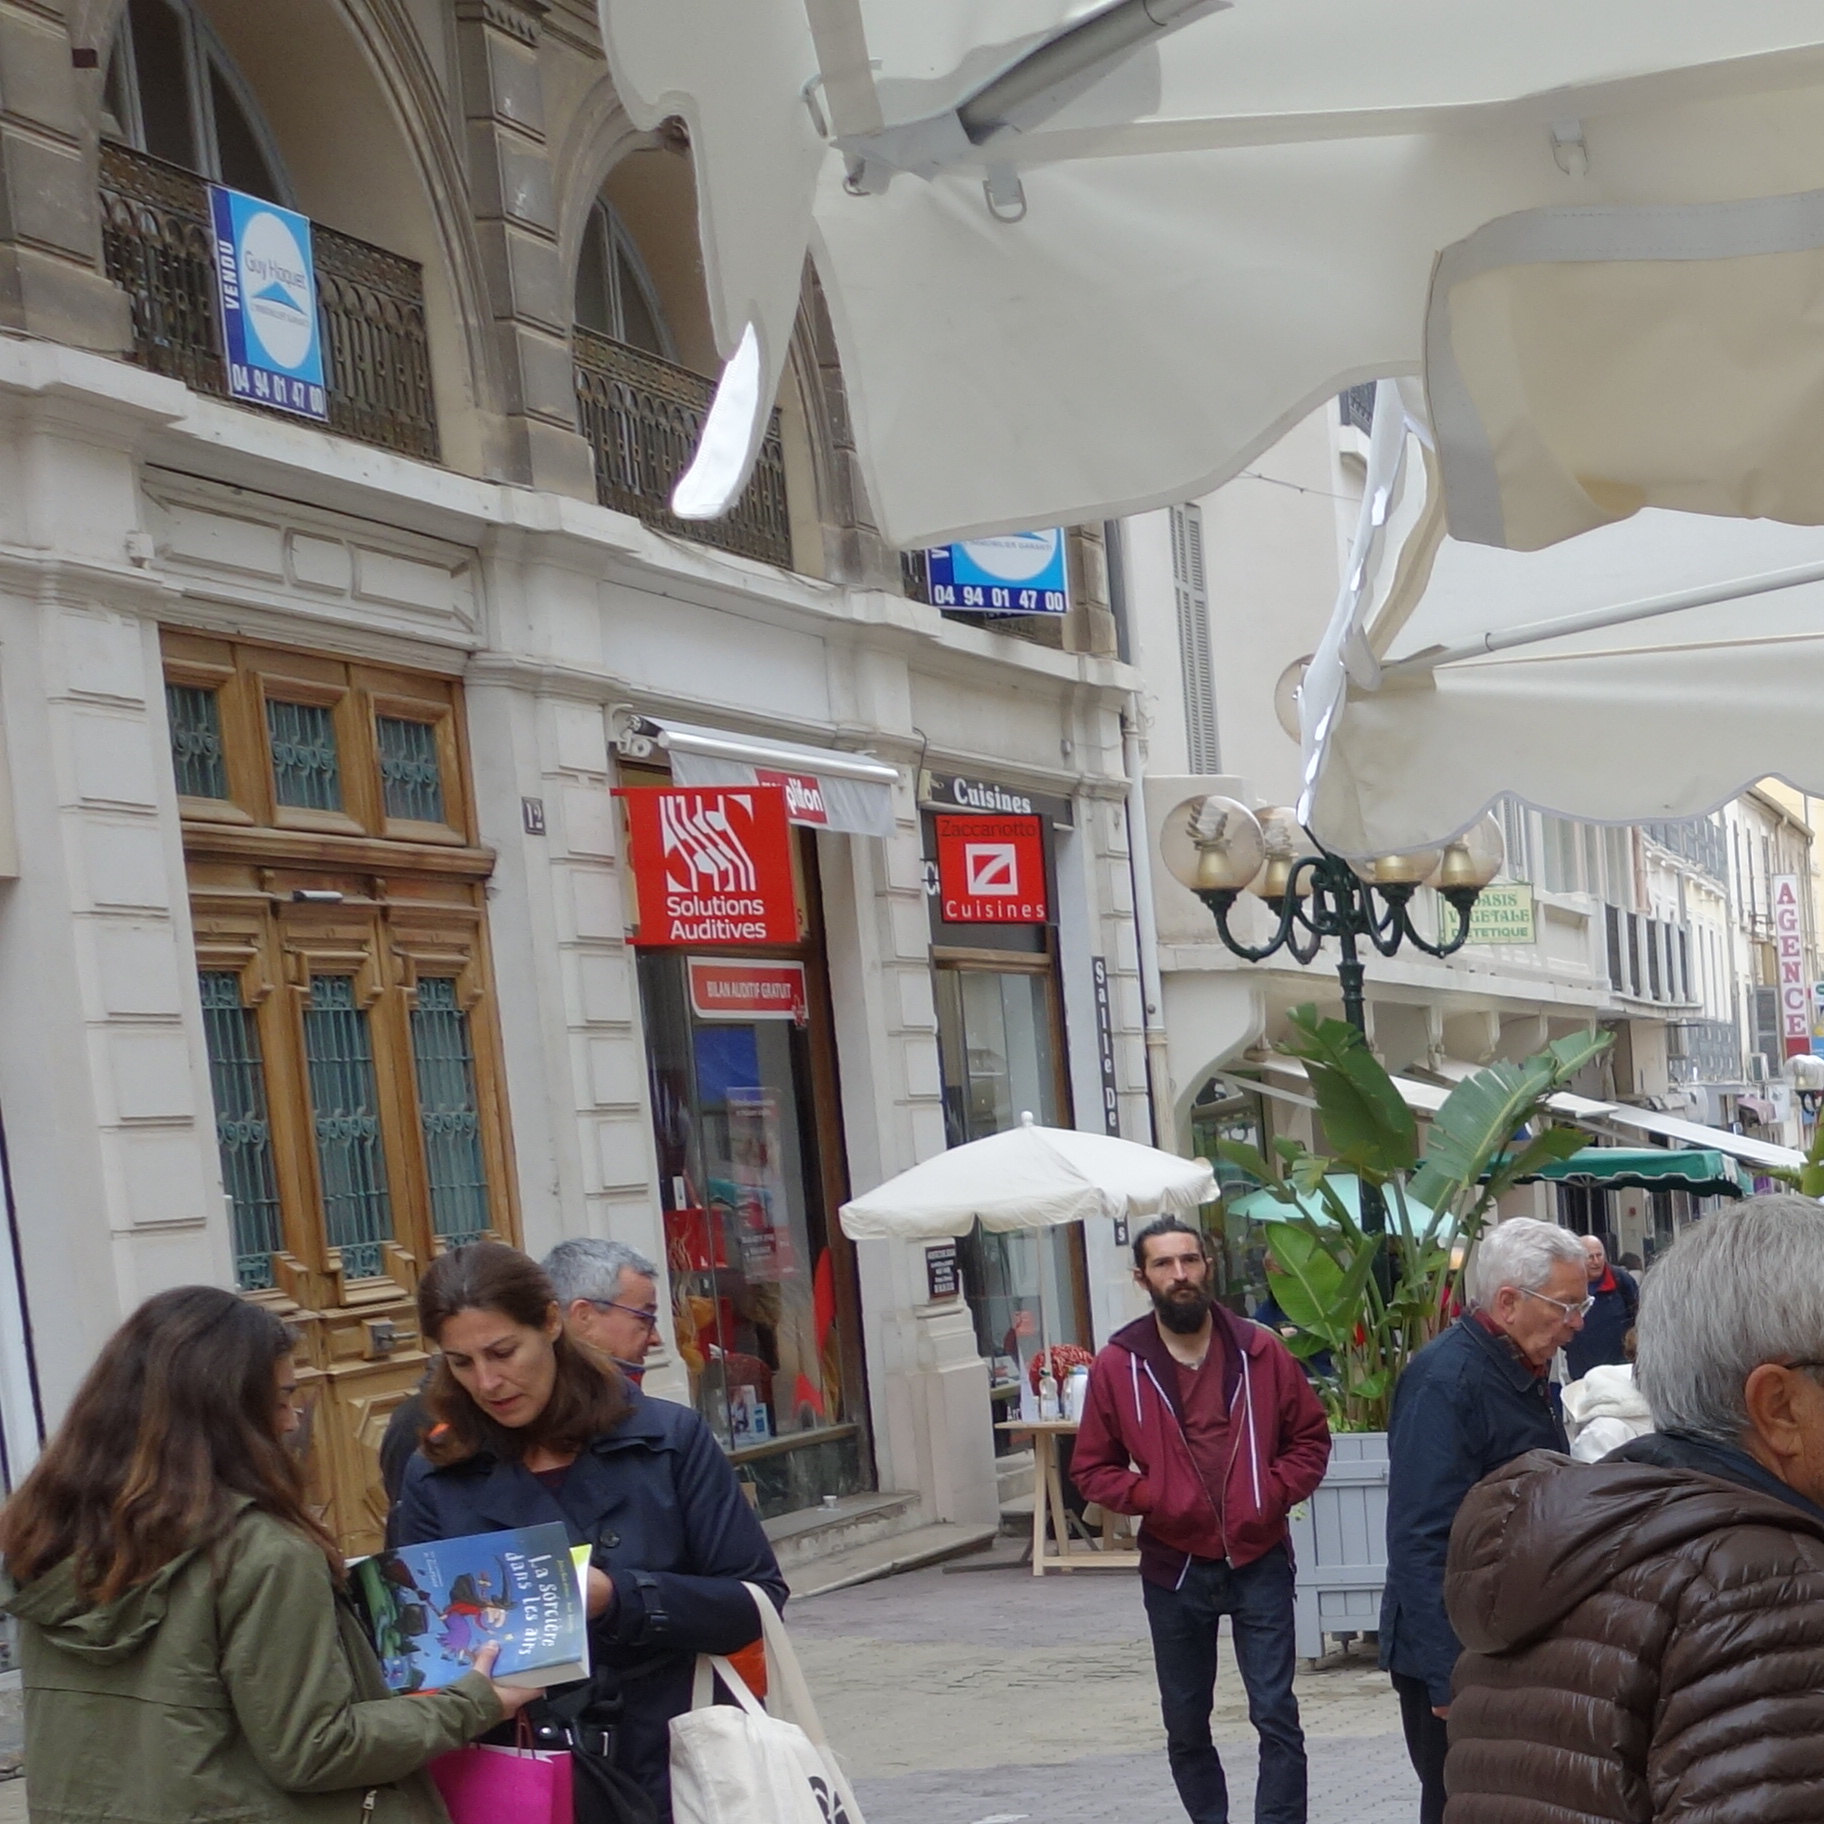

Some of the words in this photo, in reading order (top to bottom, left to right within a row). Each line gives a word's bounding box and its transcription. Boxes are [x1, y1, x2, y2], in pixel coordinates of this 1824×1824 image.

[219, 240, 240, 310] VENDU
[244, 250, 268, 281] Guy
[232, 364, 250, 393] 04
[254, 370, 270, 398] 94
[274, 375, 288, 403] 01
[292, 380, 305, 408] 47
[309, 385, 324, 414] 00
[934, 585, 955, 605] 04
[963, 586, 984, 606] 94
[991, 587, 1010, 607] 01
[1019, 590, 1037, 609] 47
[1045, 592, 1064, 611] 00
[953, 777, 1031, 814] Cuisines
[667, 895, 764, 917] Solutions
[946, 900, 1045, 918] Cuisines
[1448, 909, 1530, 923] VGETALE
[670, 919, 767, 941] Auditives
[1777, 882, 1807, 1036] AGENCE
[761, 982, 792, 999] GRATUIT
[1094, 960, 1112, 1073] Salle
[1105, 1086, 1117, 1127] De
[504, 1552, 532, 1589] dans
[528, 1554, 552, 1579] La
[522, 1596, 542, 1621] les
[518, 1627, 542, 1655] airs
